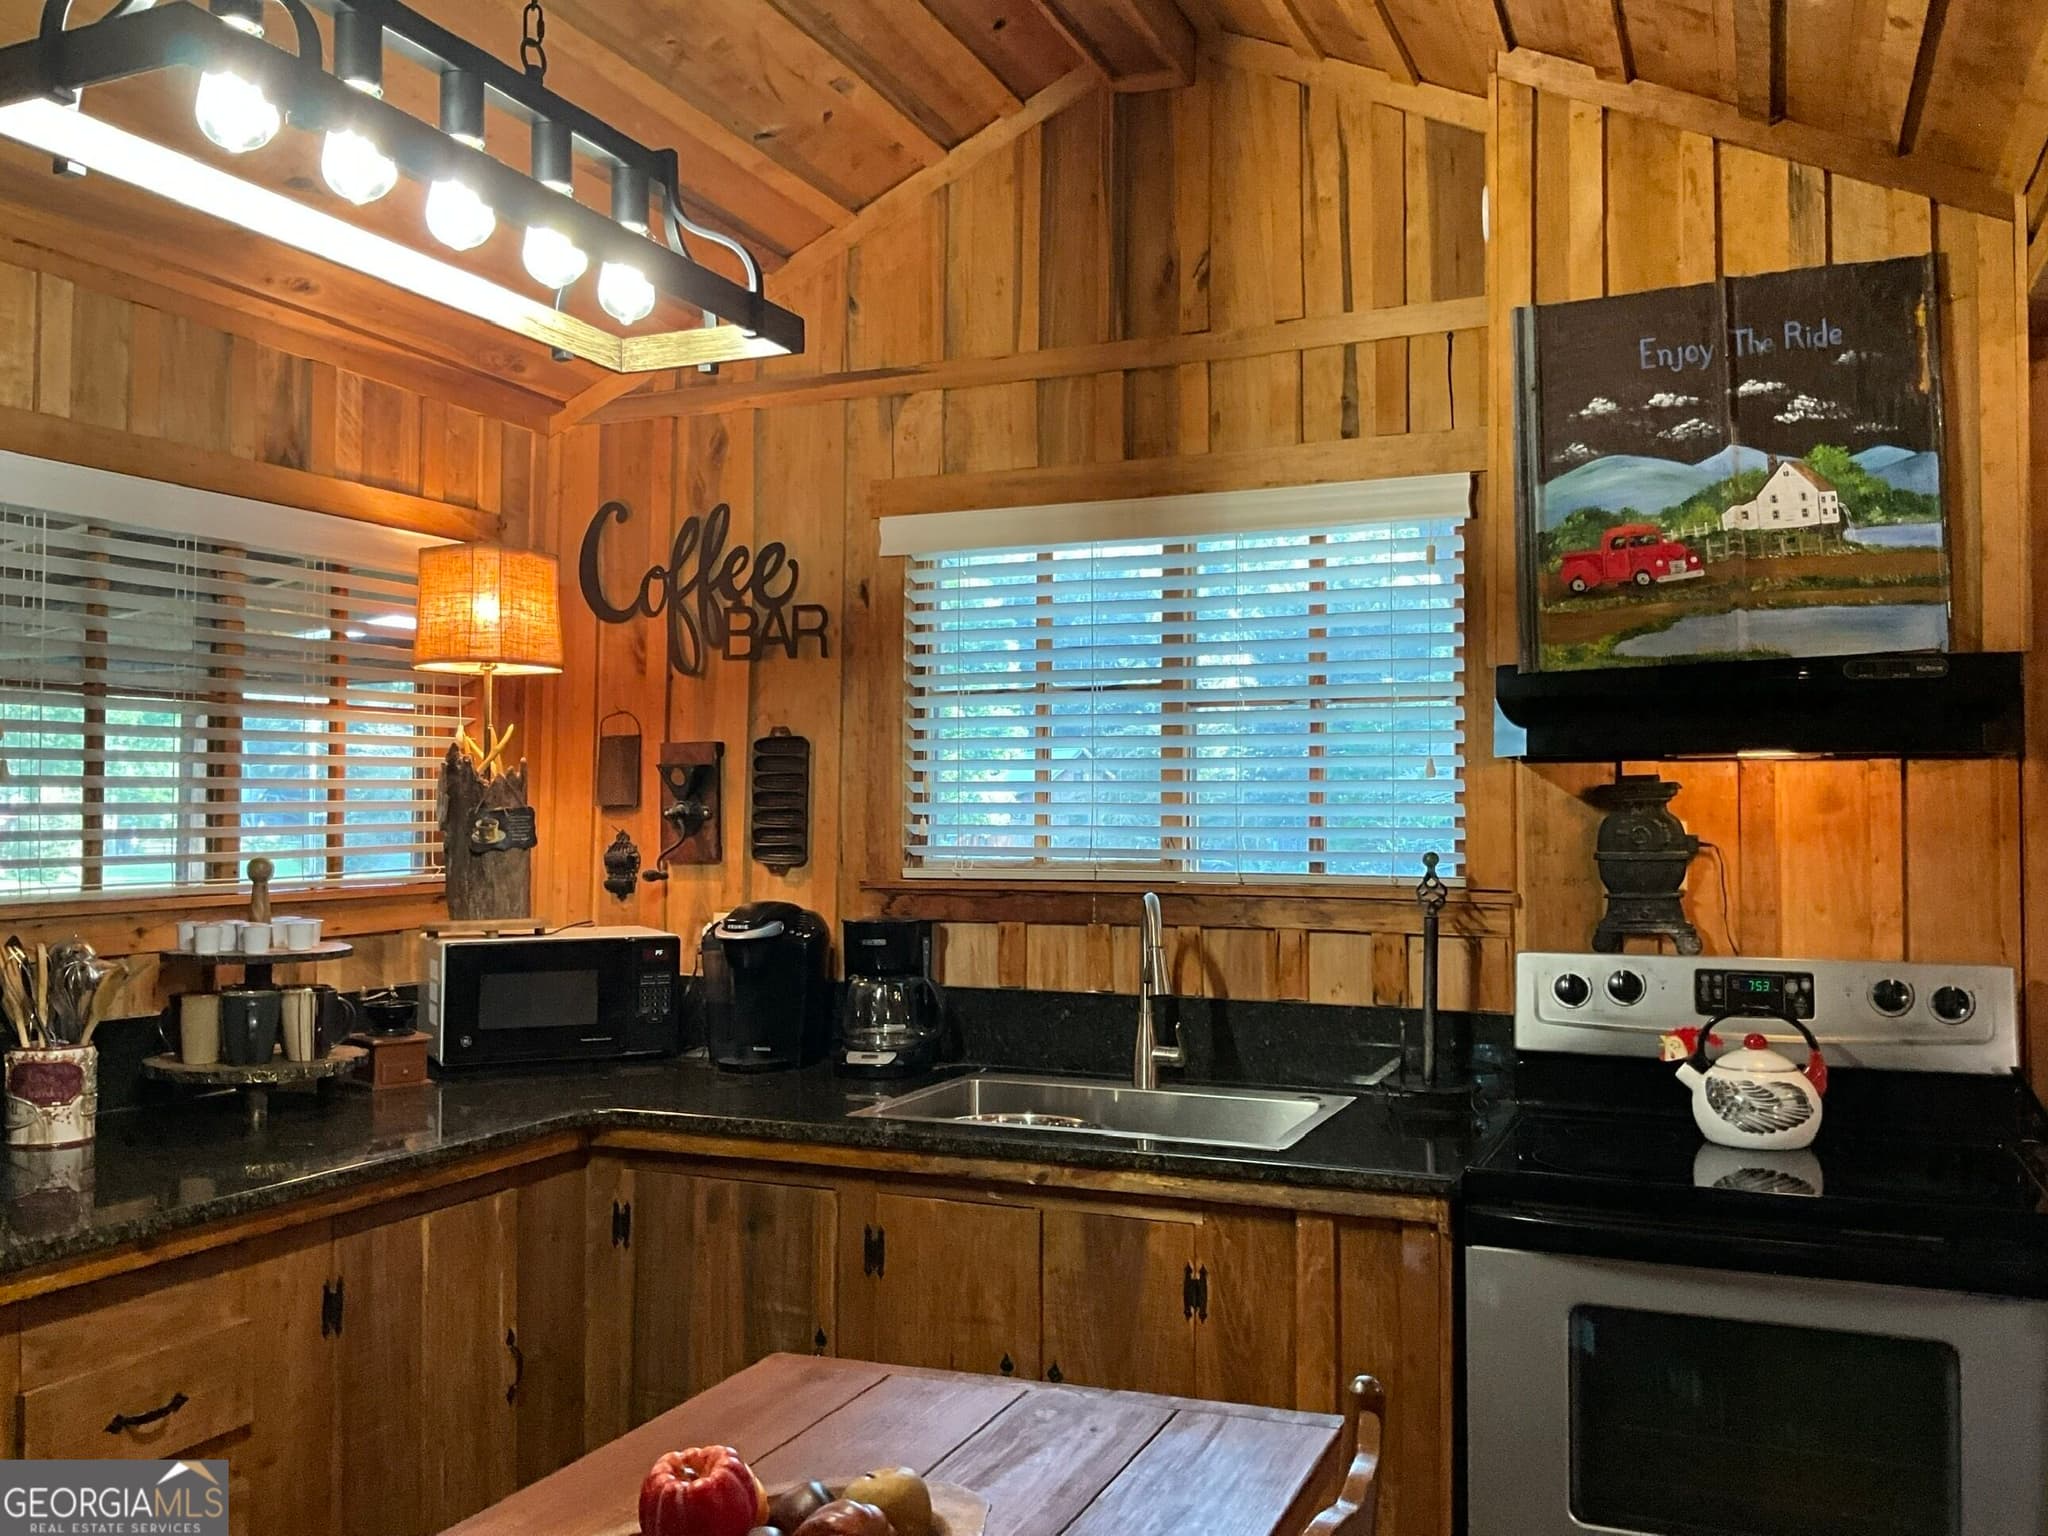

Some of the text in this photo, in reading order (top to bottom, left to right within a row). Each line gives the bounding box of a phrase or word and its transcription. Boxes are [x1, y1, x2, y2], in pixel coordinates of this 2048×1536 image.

[1639, 317, 1843, 372] Enjoy The Ride
[579, 502, 799, 676] Coffee
[722, 603, 829, 661] BAR
